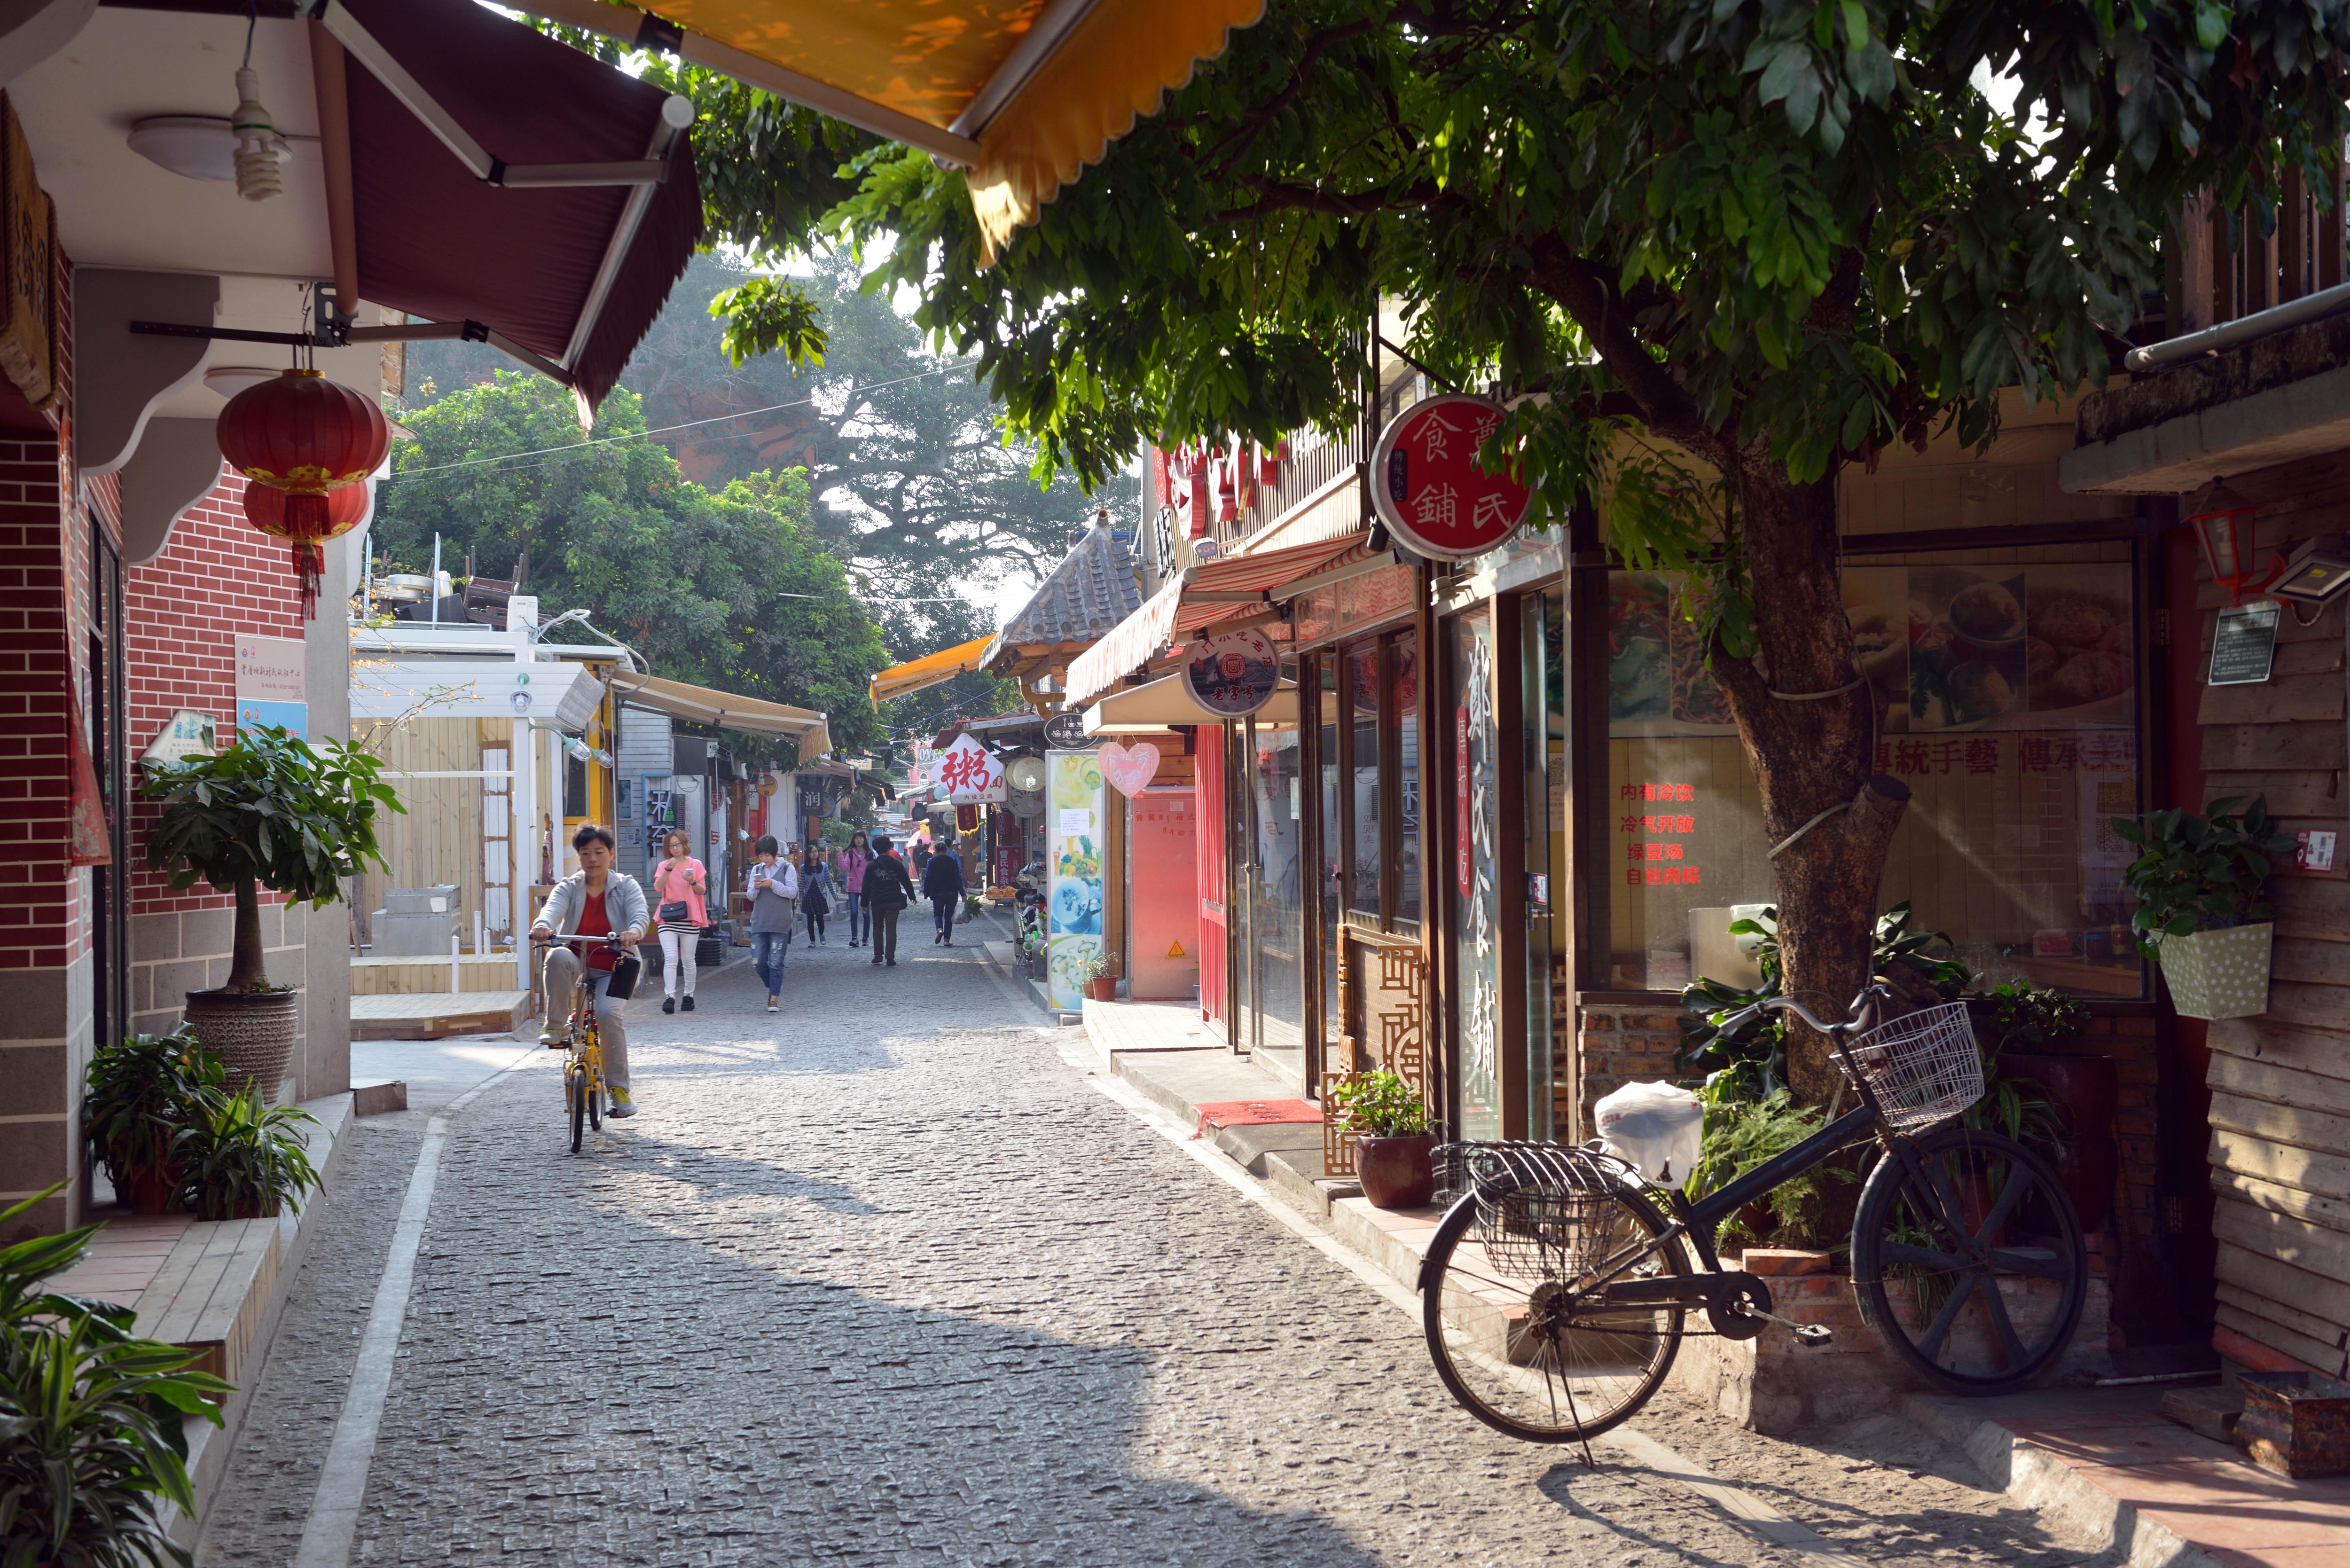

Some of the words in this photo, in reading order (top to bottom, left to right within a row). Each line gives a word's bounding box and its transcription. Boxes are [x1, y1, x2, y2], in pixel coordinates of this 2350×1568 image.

[1212, 684, 1256, 701] 老字号
[940, 747, 990, 794] 粥
[805, 791, 820, 806] 润
[1457, 716, 1468, 886] 傳統小吃
[1621, 783, 1694, 801] 内有冷饮
[1620, 815, 1695, 833] 冷气开放
[1627, 844, 1684, 861] 绿豆汤
[1626, 866, 1700, 886] 自包肉粽
